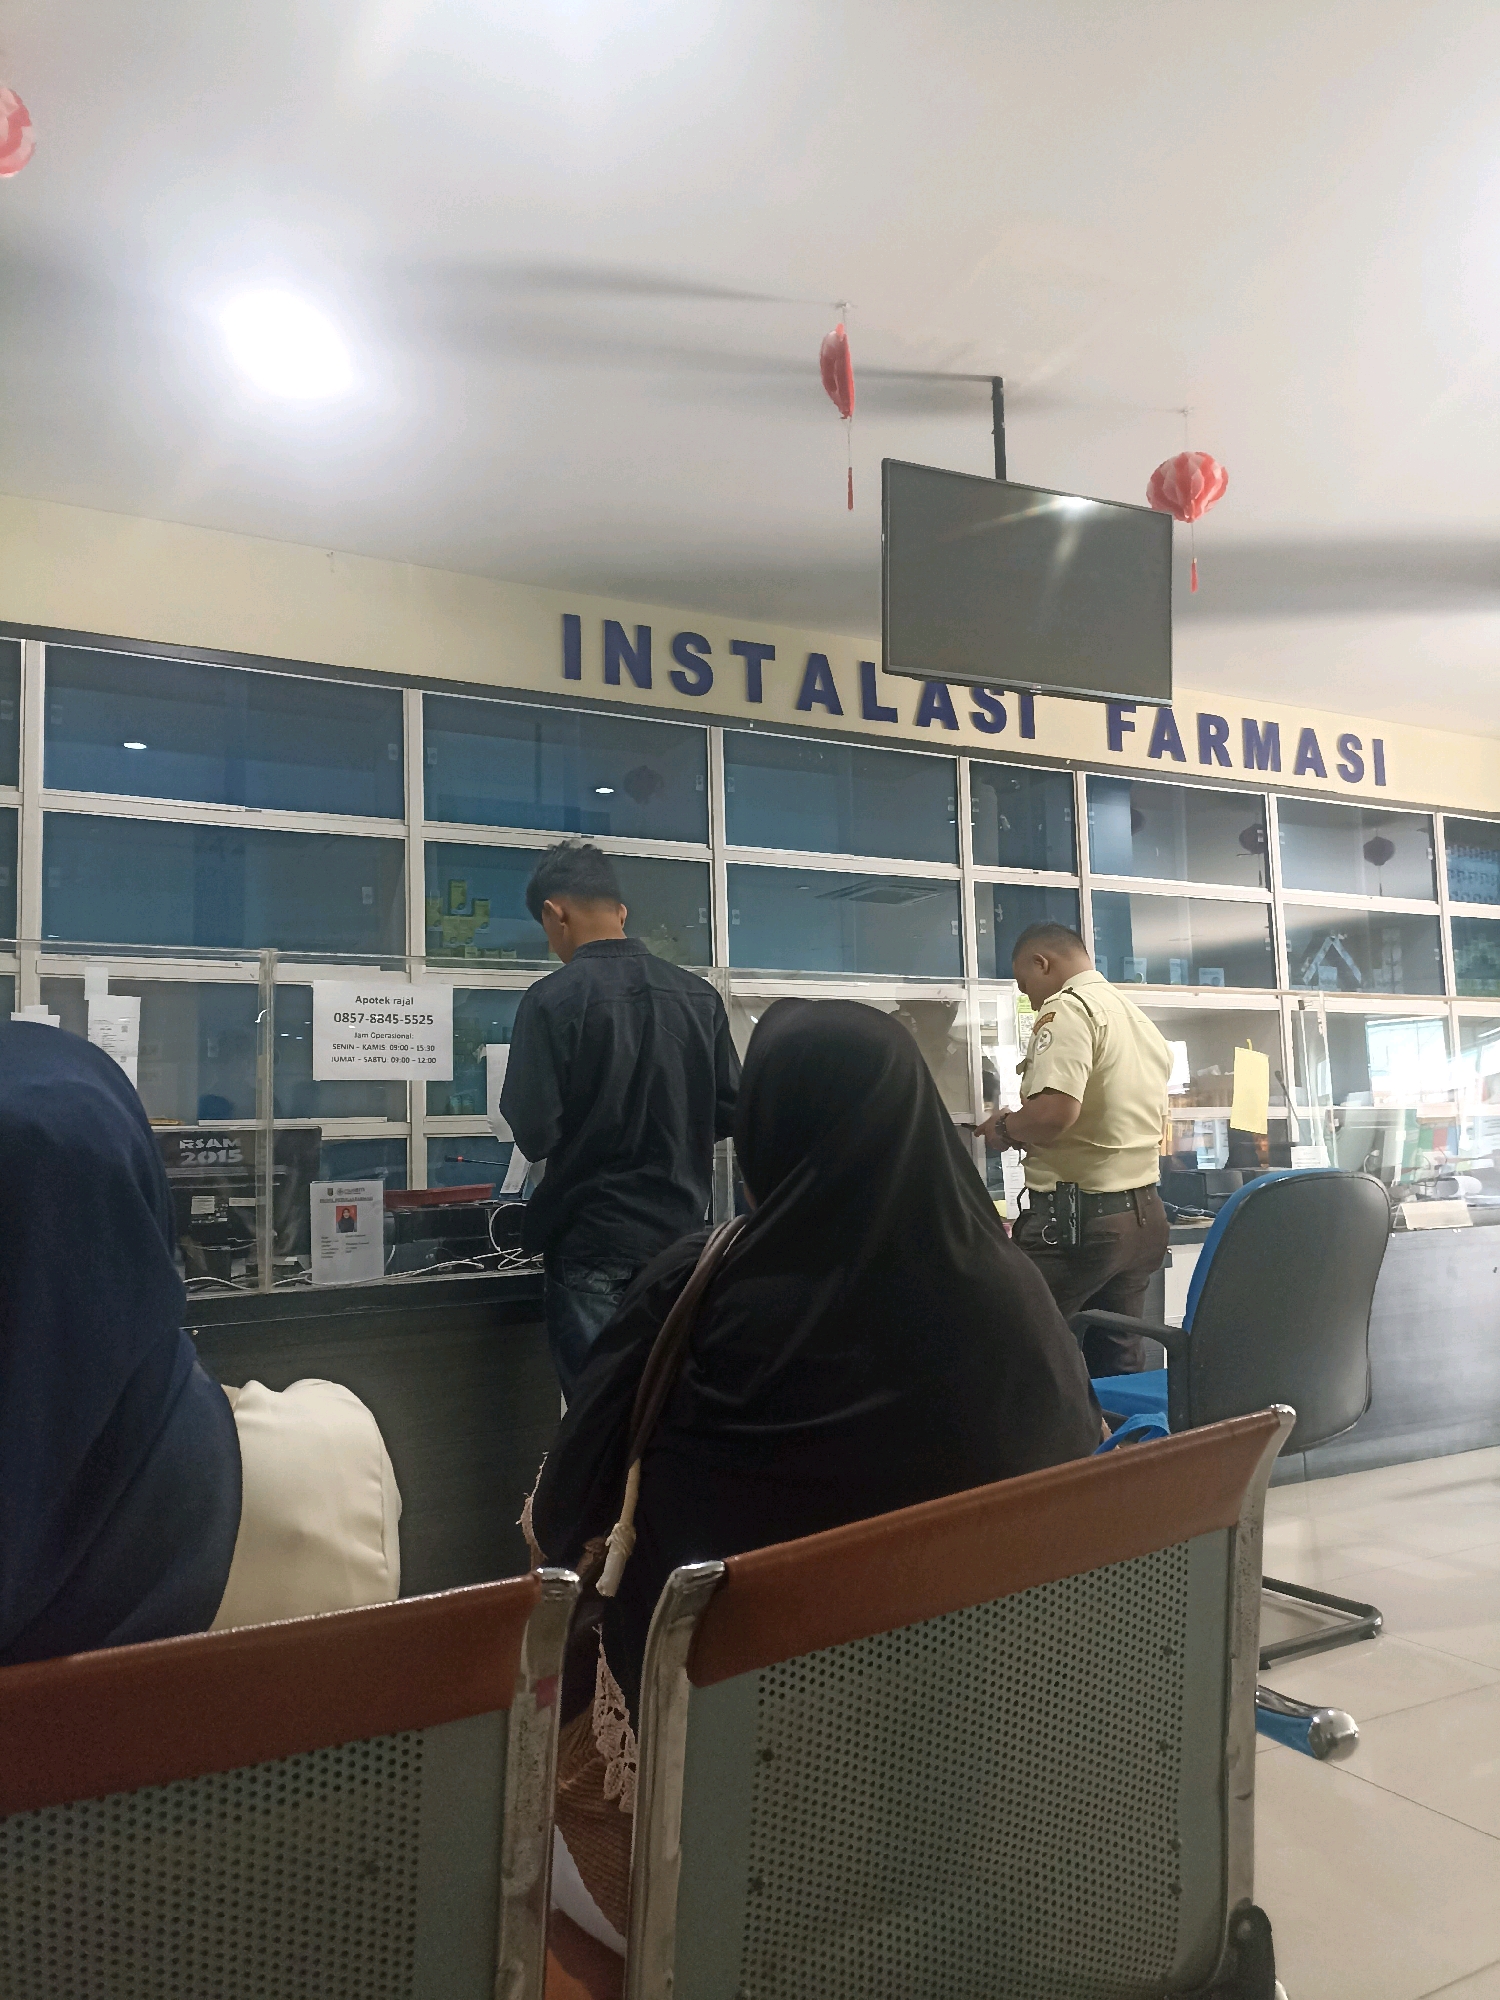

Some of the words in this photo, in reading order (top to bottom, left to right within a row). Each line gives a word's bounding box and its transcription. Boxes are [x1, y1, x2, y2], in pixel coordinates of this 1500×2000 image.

[562, 613, 1036, 740] INSTALASI
[1108, 702, 1387, 787] FARMASI
[355, 995, 390, 1005] Apotek
[393, 997, 414, 1006] rajal
[333, 1012, 434, 1025] 0857-8845-5525
[180, 1149, 243, 1166] 2015
